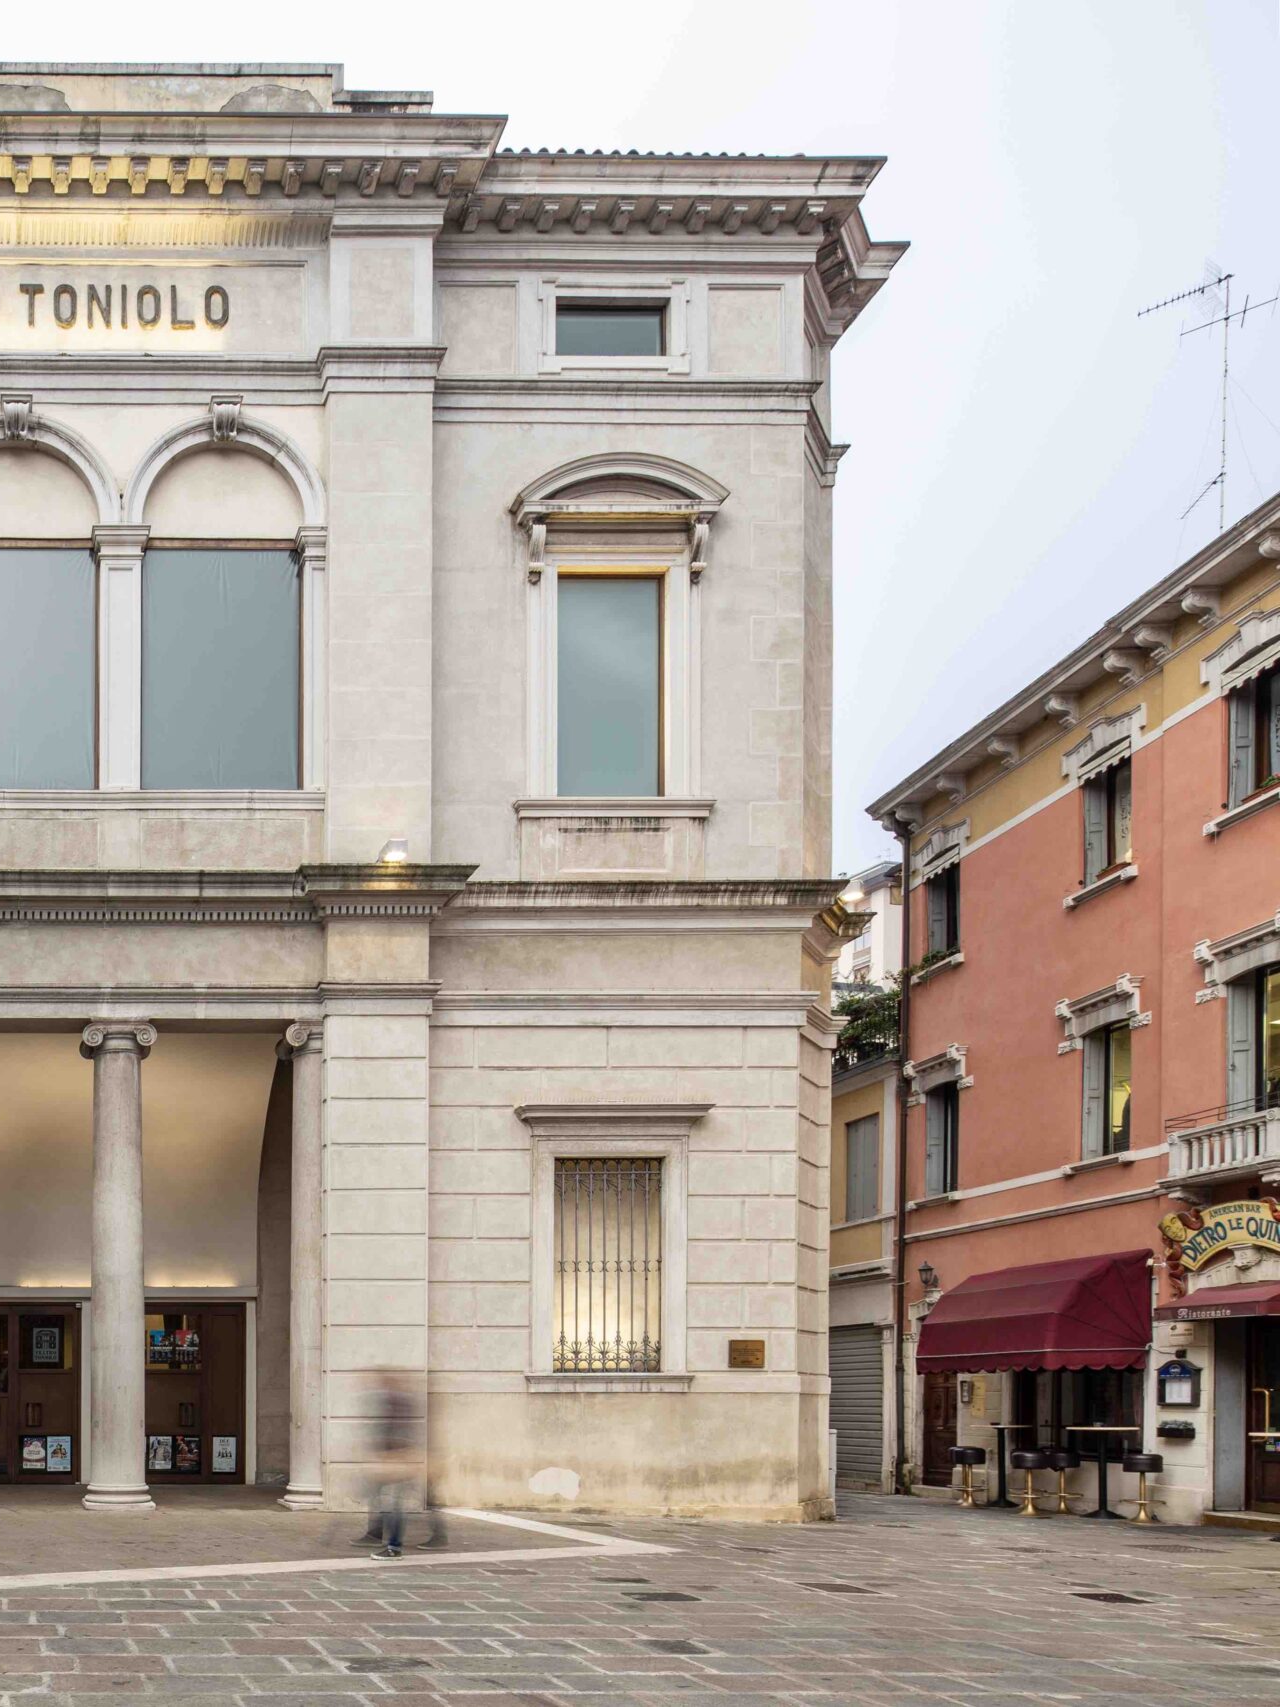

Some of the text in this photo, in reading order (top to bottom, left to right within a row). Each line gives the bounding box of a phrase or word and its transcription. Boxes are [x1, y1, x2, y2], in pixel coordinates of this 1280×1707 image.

[20, 283, 230, 330] TONIOLO
[1209, 1203, 1262, 1220] AMERICAN BAR
[1182, 1220, 1228, 1263] DIETRO
[1227, 1217, 1245, 1231] LE
[1177, 1308, 1232, 1319] Ristorante
